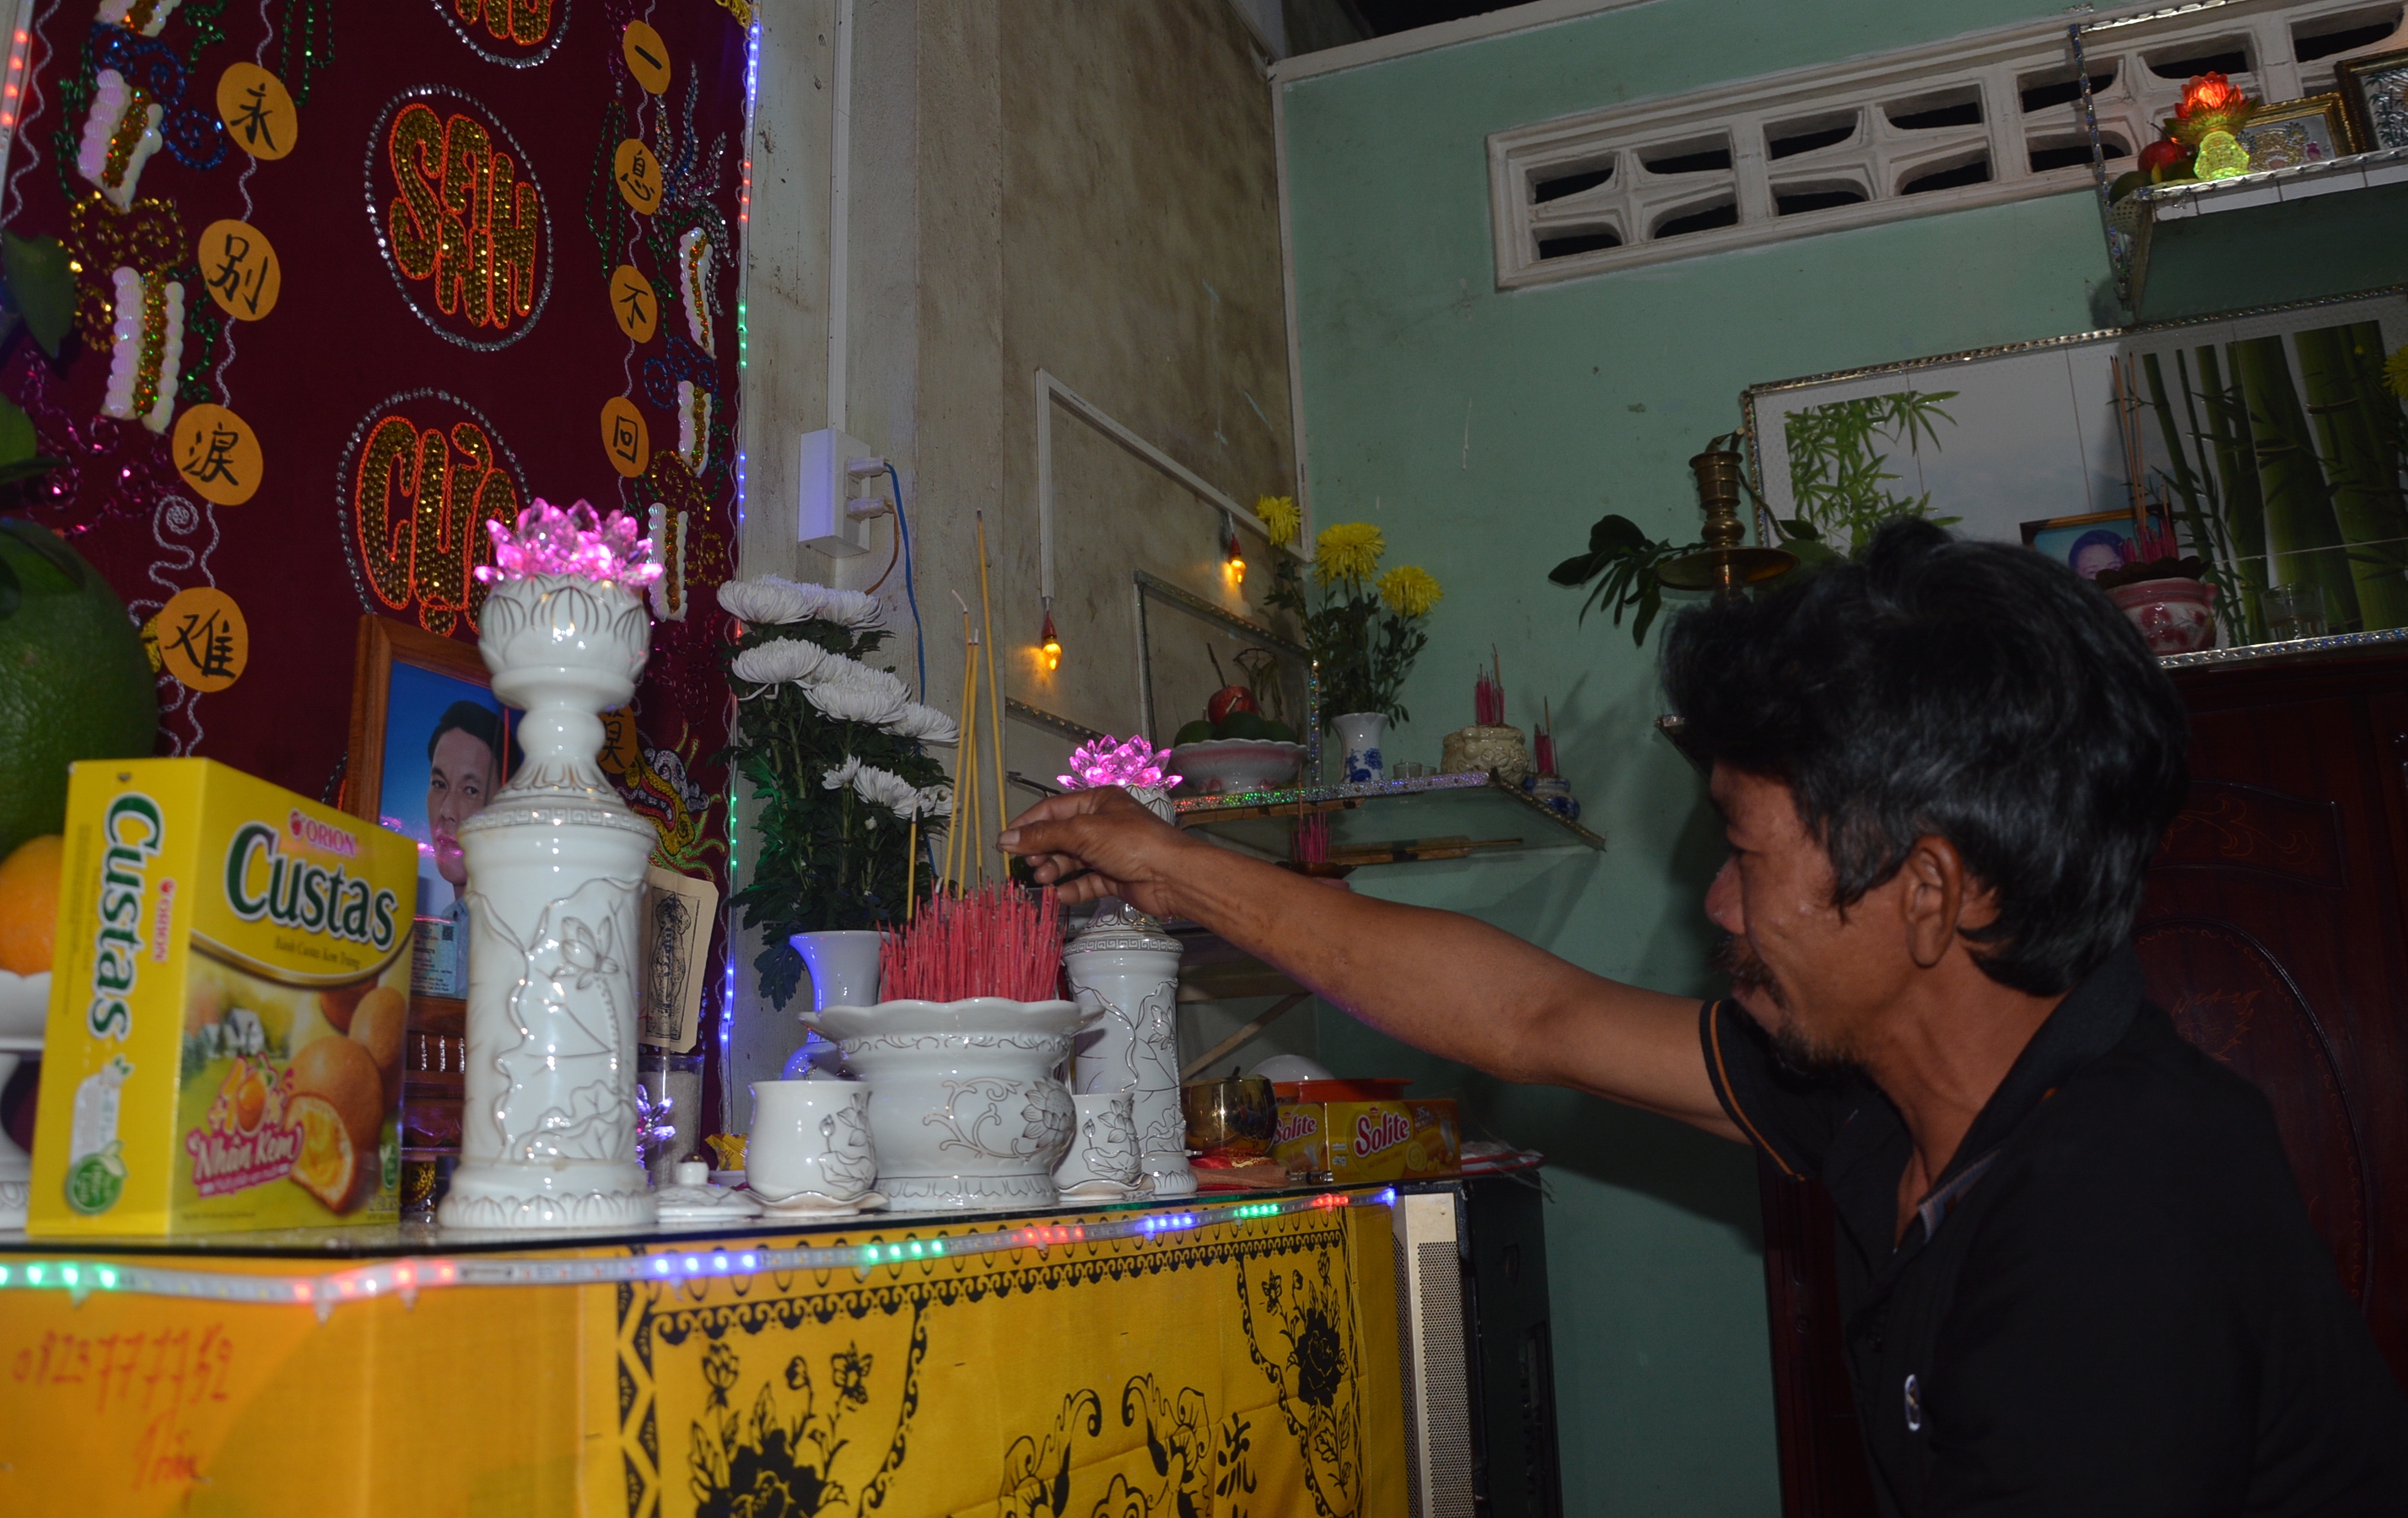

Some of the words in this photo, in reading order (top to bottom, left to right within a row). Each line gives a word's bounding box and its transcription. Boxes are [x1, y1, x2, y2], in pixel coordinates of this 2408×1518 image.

[305, 817, 357, 858] ORION
[88, 791, 165, 1043] Custas
[224, 819, 399, 952] Custas
[152, 898, 174, 963] ORION
[1354, 1111, 1411, 1158] Solite
